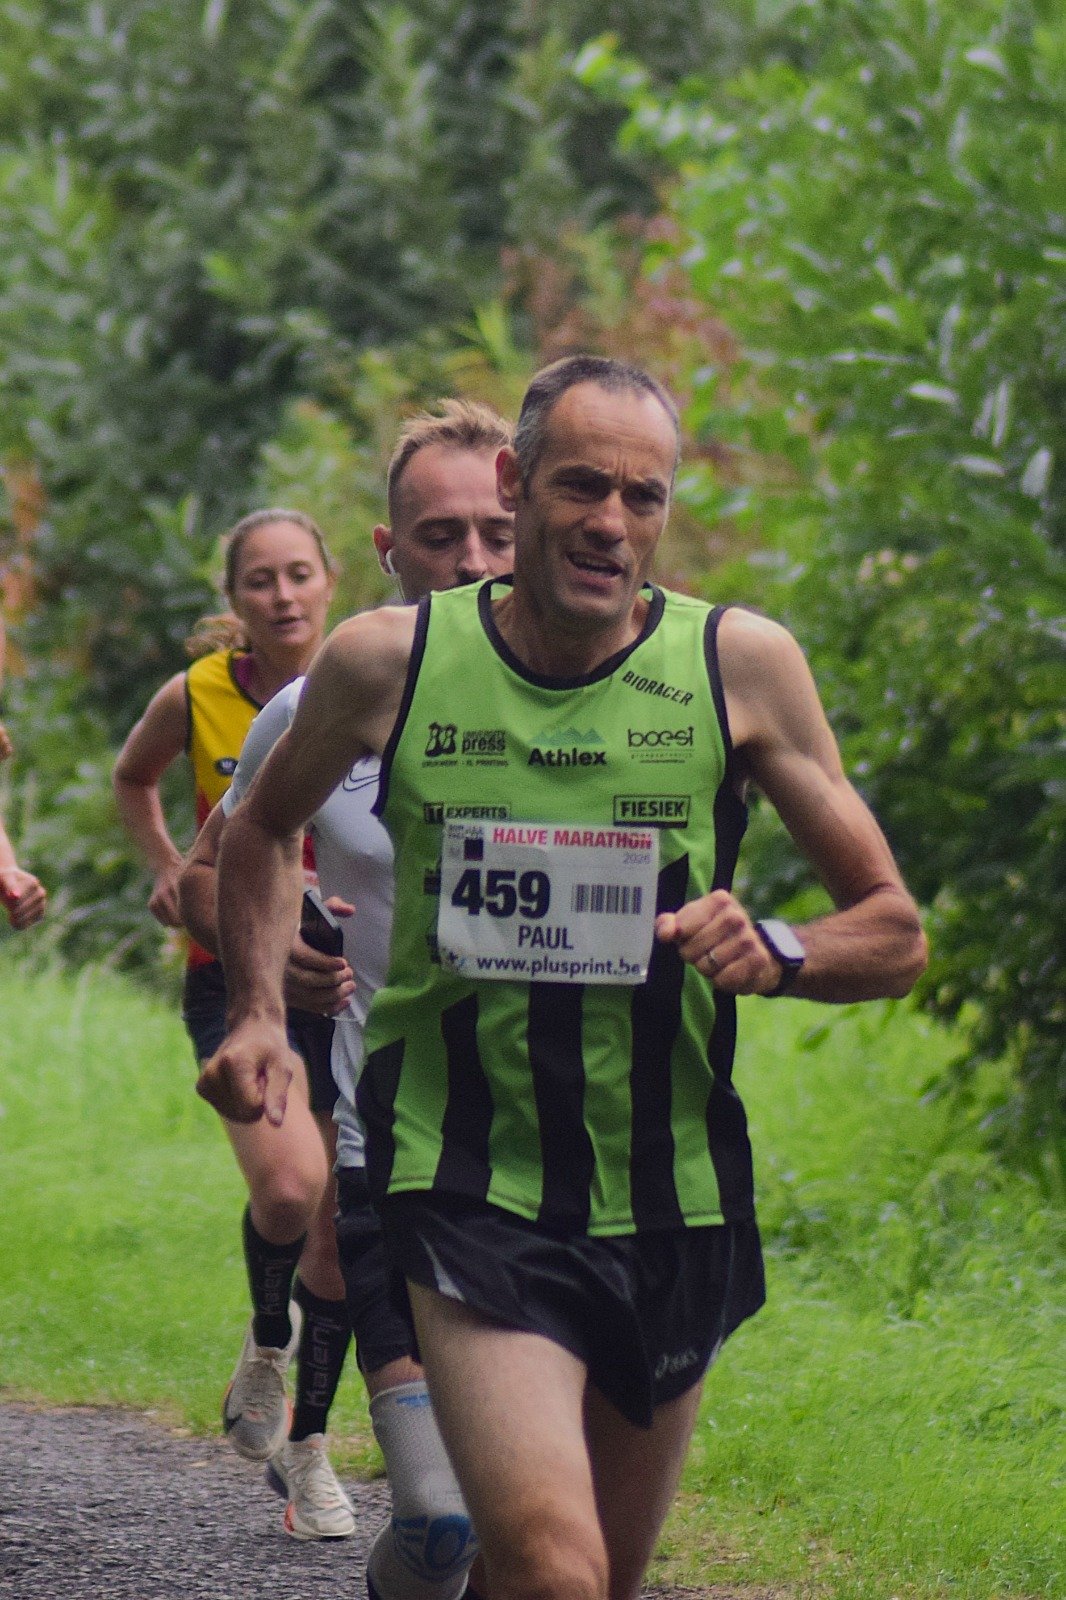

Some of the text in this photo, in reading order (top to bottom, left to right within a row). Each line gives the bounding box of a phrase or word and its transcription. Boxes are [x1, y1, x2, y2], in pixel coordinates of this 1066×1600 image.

[622, 670, 694, 706] BIORACER
[461, 735, 506, 755] press
[528, 747, 607, 767] Athlex
[446, 806, 507, 819] EXPERTS
[621, 801, 685, 818] FIESIEK
[492, 827, 548, 845] HALVE
[553, 830, 652, 849] MARATHON
[451, 868, 550, 919] 459
[518, 925, 574, 950] PAUL
[477, 954, 641, 978] www.plusprint.be
